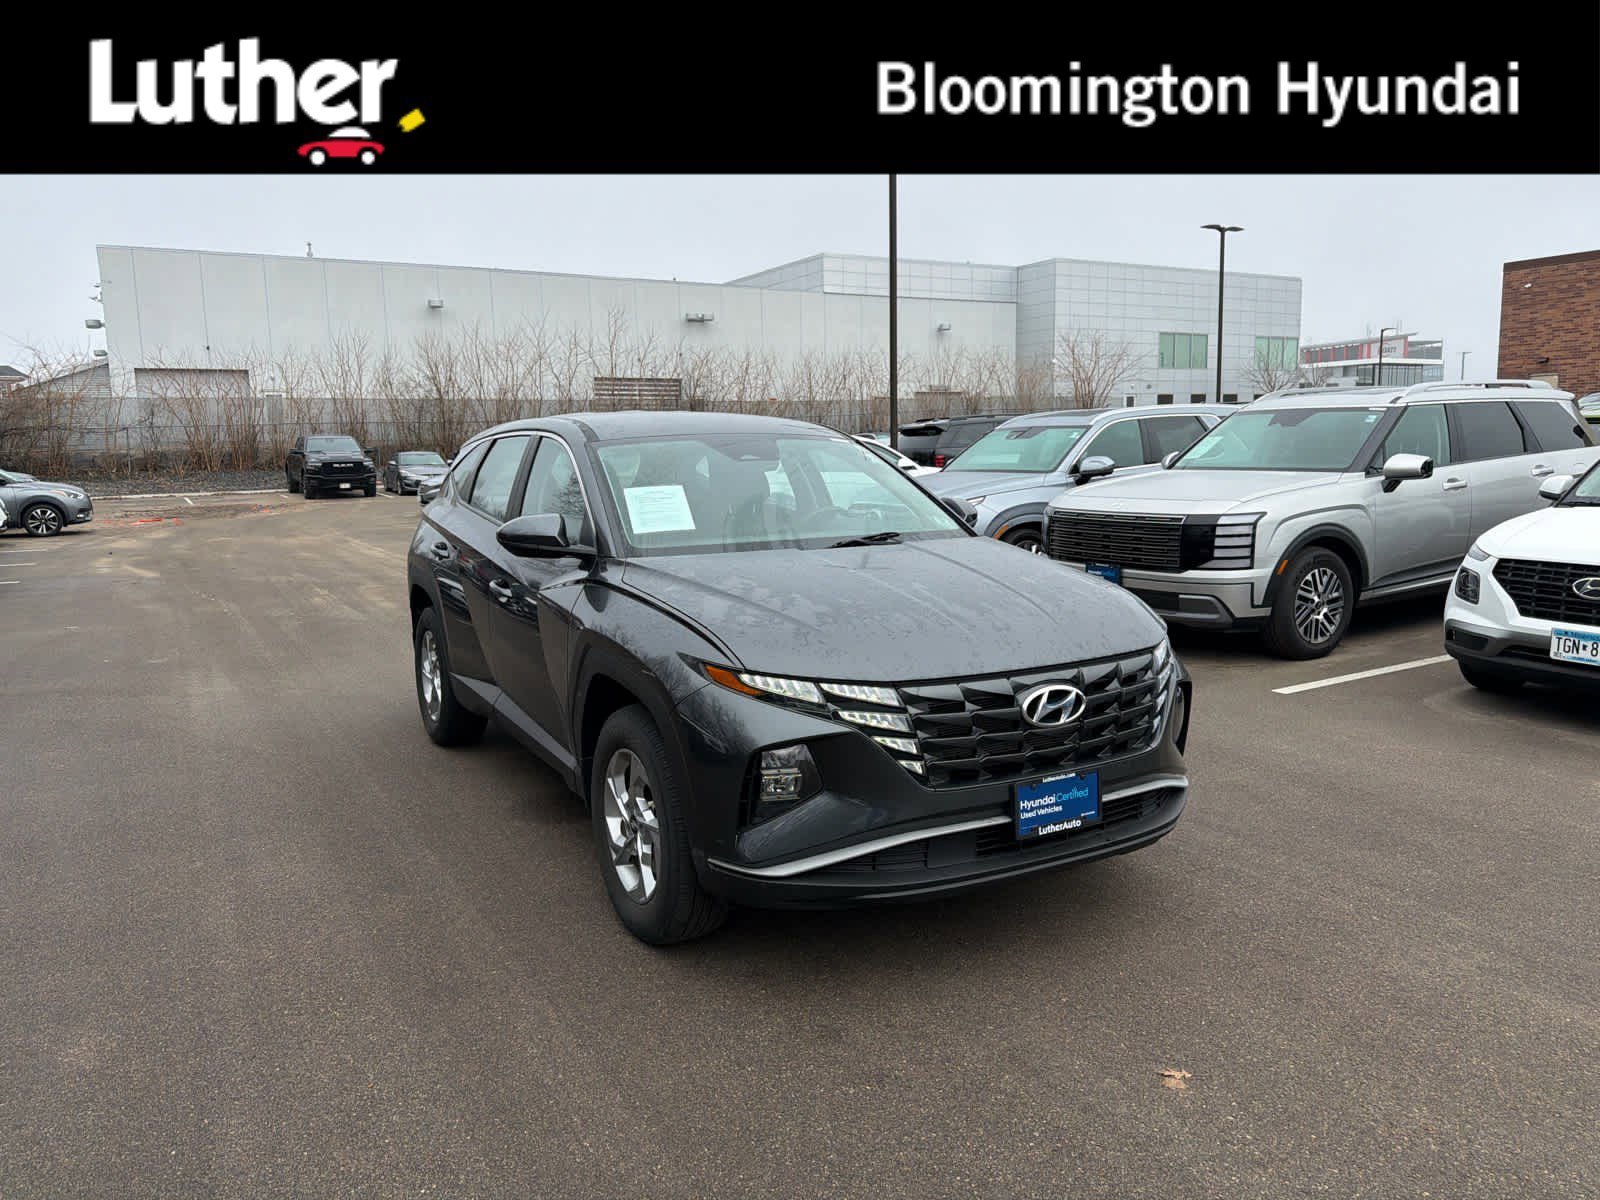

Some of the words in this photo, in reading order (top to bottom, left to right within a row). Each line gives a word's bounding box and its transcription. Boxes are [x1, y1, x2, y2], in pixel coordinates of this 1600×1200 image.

[1556, 636, 1580, 654] TGN
[1020, 794, 1056, 811] Hyundai
[1056, 787, 1088, 802] Certified
[1020, 811, 1037, 819] Used
[1037, 804, 1063, 815] Vehicles
[1038, 819, 1082, 835] LutherAuto
